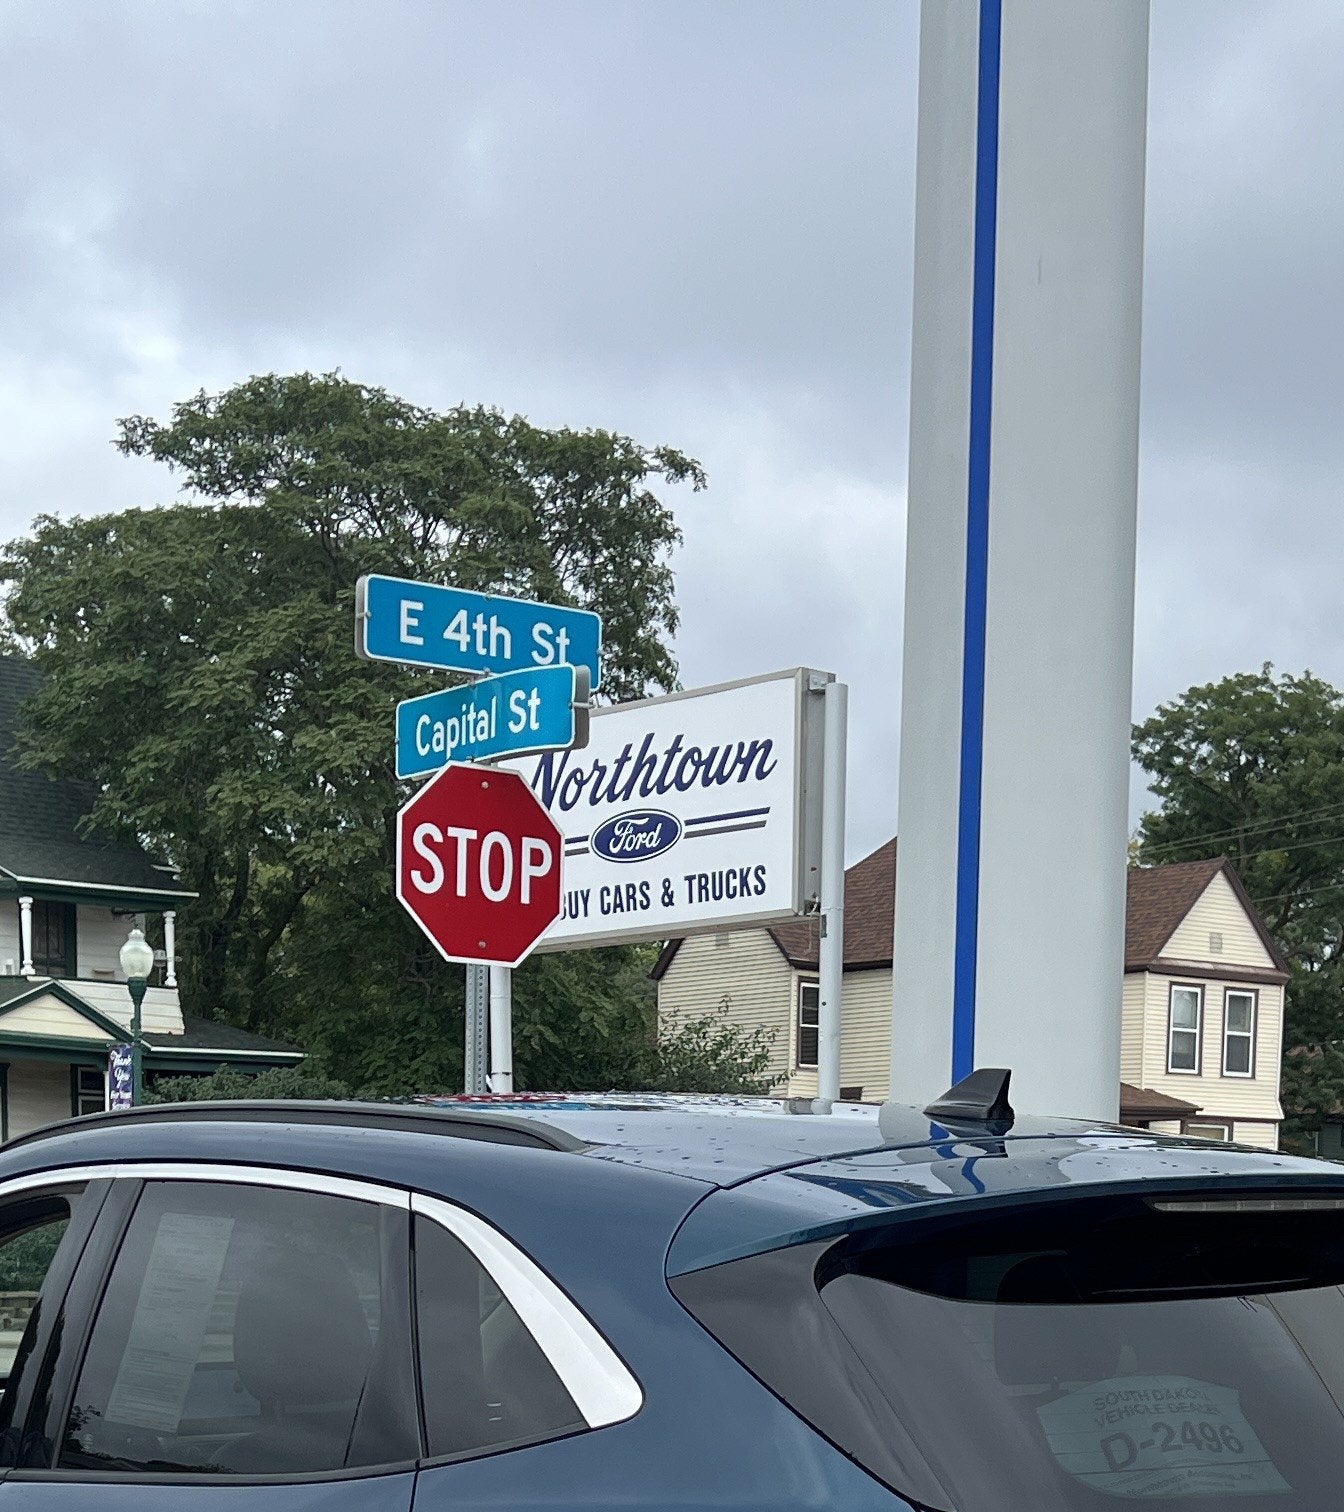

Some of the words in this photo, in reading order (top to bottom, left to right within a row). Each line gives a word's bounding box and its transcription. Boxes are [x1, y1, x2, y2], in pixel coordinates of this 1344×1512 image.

[399, 601, 424, 645] E
[442, 609, 512, 659] 4th
[531, 622, 571, 665] St
[415, 707, 497, 761] Capital
[508, 689, 541, 732] St
[531, 732, 778, 811] Northtown
[608, 817, 662, 854] Ford
[410, 822, 554, 905] STOP
[599, 881, 651, 916] CARS
[660, 878, 675, 908] &
[684, 864, 767, 905] TRUCKS
[1092, 1389, 1150, 1411] SOUTH
[1093, 1403, 1166, 1428] VEHICLE
[1100, 1420, 1245, 1473] D-2496
